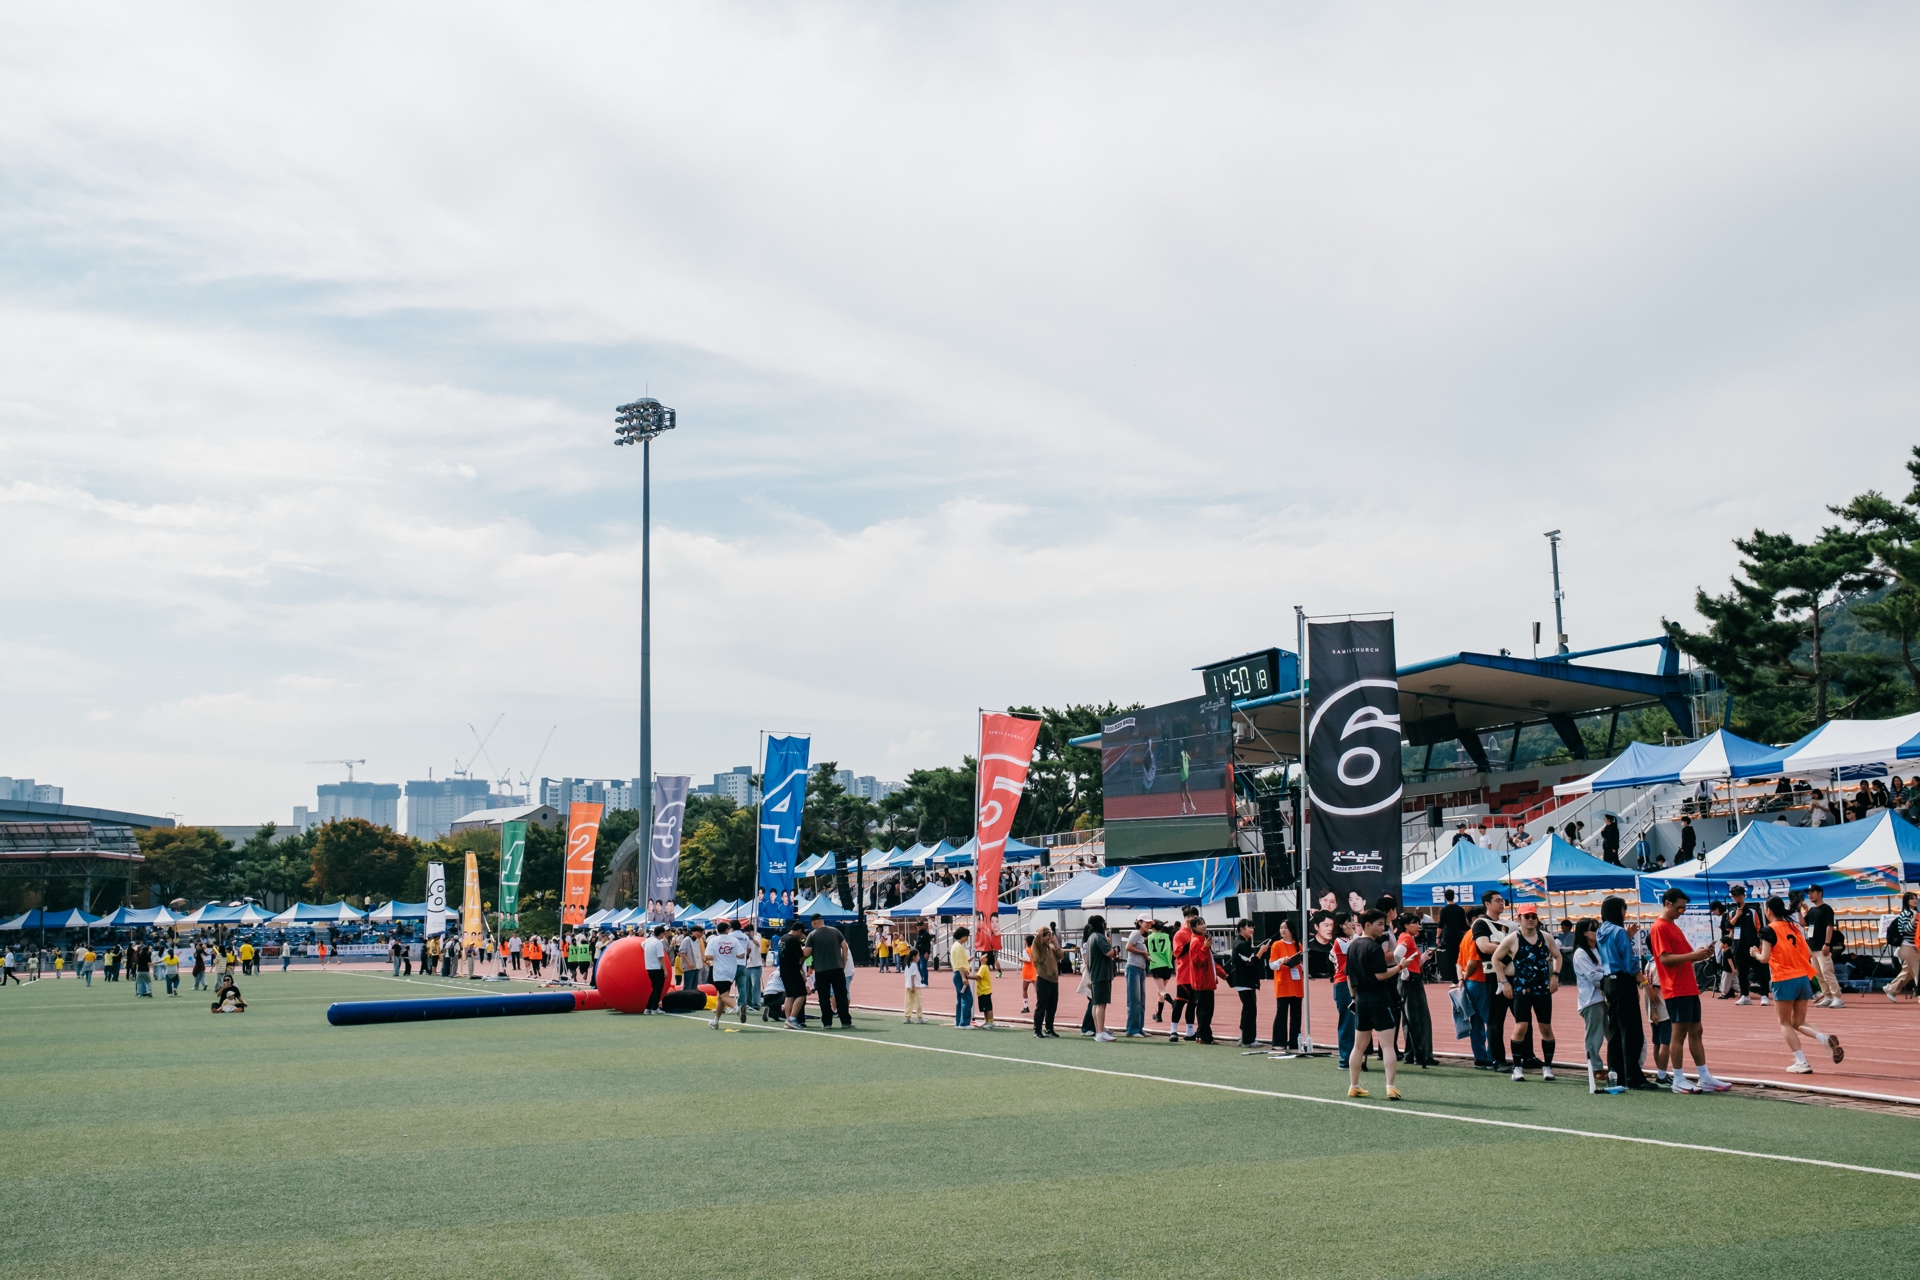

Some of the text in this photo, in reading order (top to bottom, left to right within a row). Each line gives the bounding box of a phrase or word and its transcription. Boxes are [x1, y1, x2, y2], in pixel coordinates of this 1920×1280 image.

[1213, 666, 1268, 696] 11:50 18
[502, 841, 525, 885] 1
[567, 822, 600, 873] 2
[1151, 938, 1166, 953] 17
